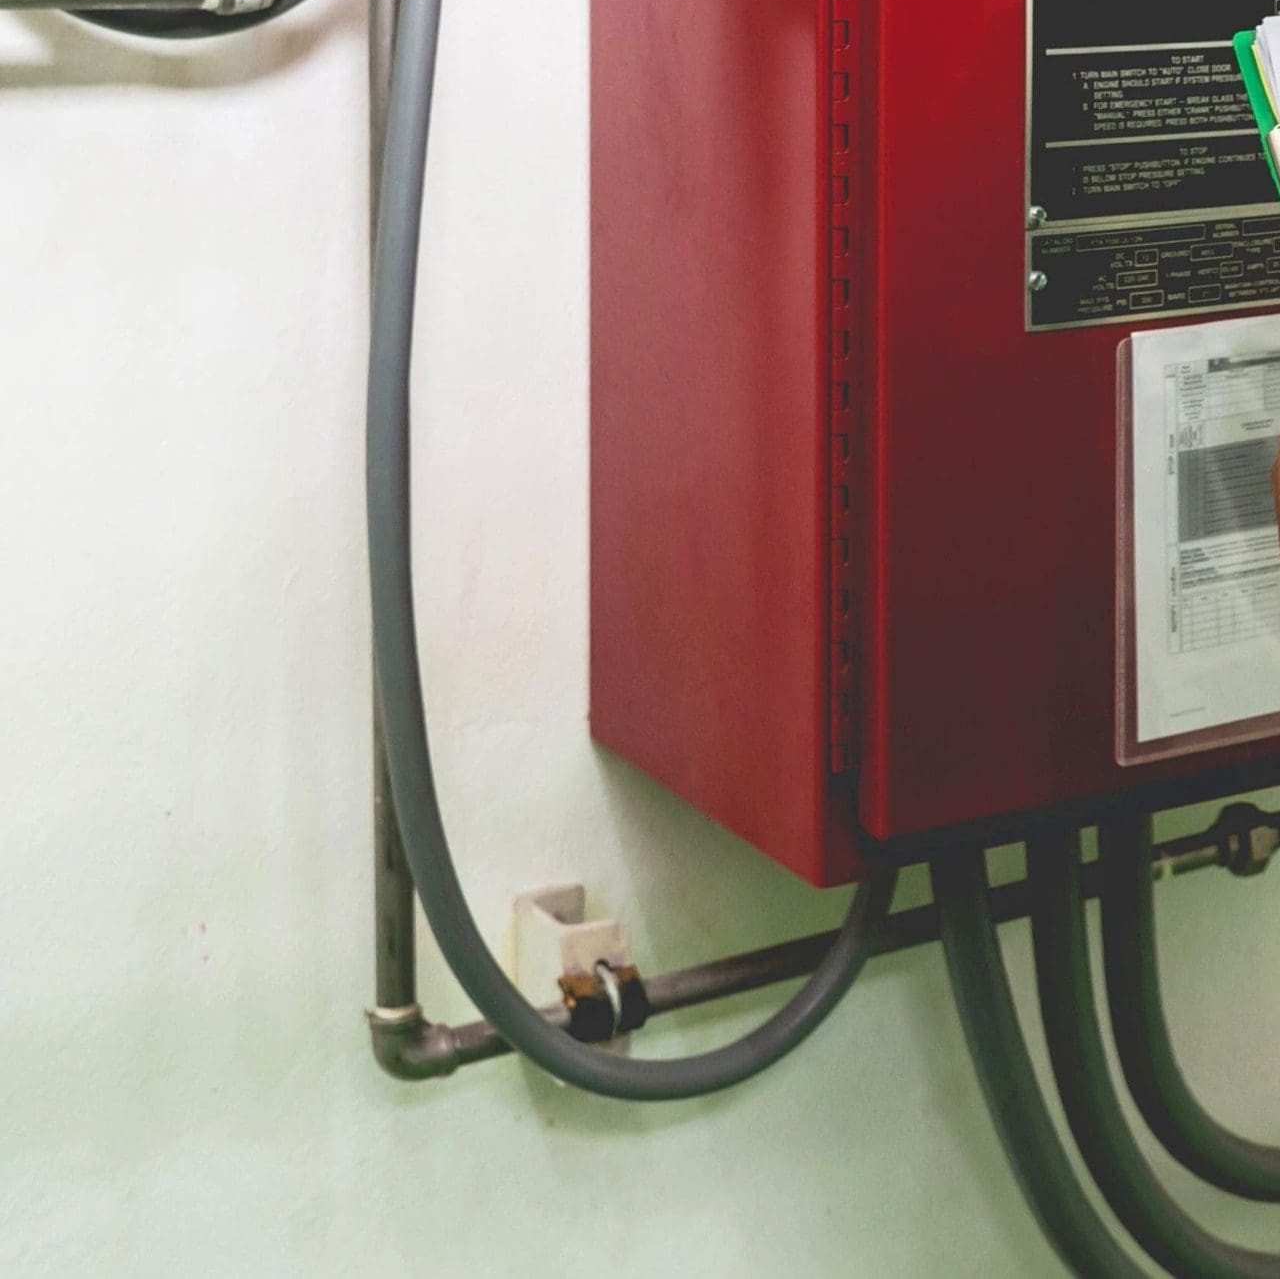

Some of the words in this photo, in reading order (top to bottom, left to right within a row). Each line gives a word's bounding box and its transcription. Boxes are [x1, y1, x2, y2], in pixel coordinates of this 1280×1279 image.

[1171, 56, 1180, 64] TO
[1182, 55, 1204, 64] START
[1190, 146, 1208, 154] STOP
